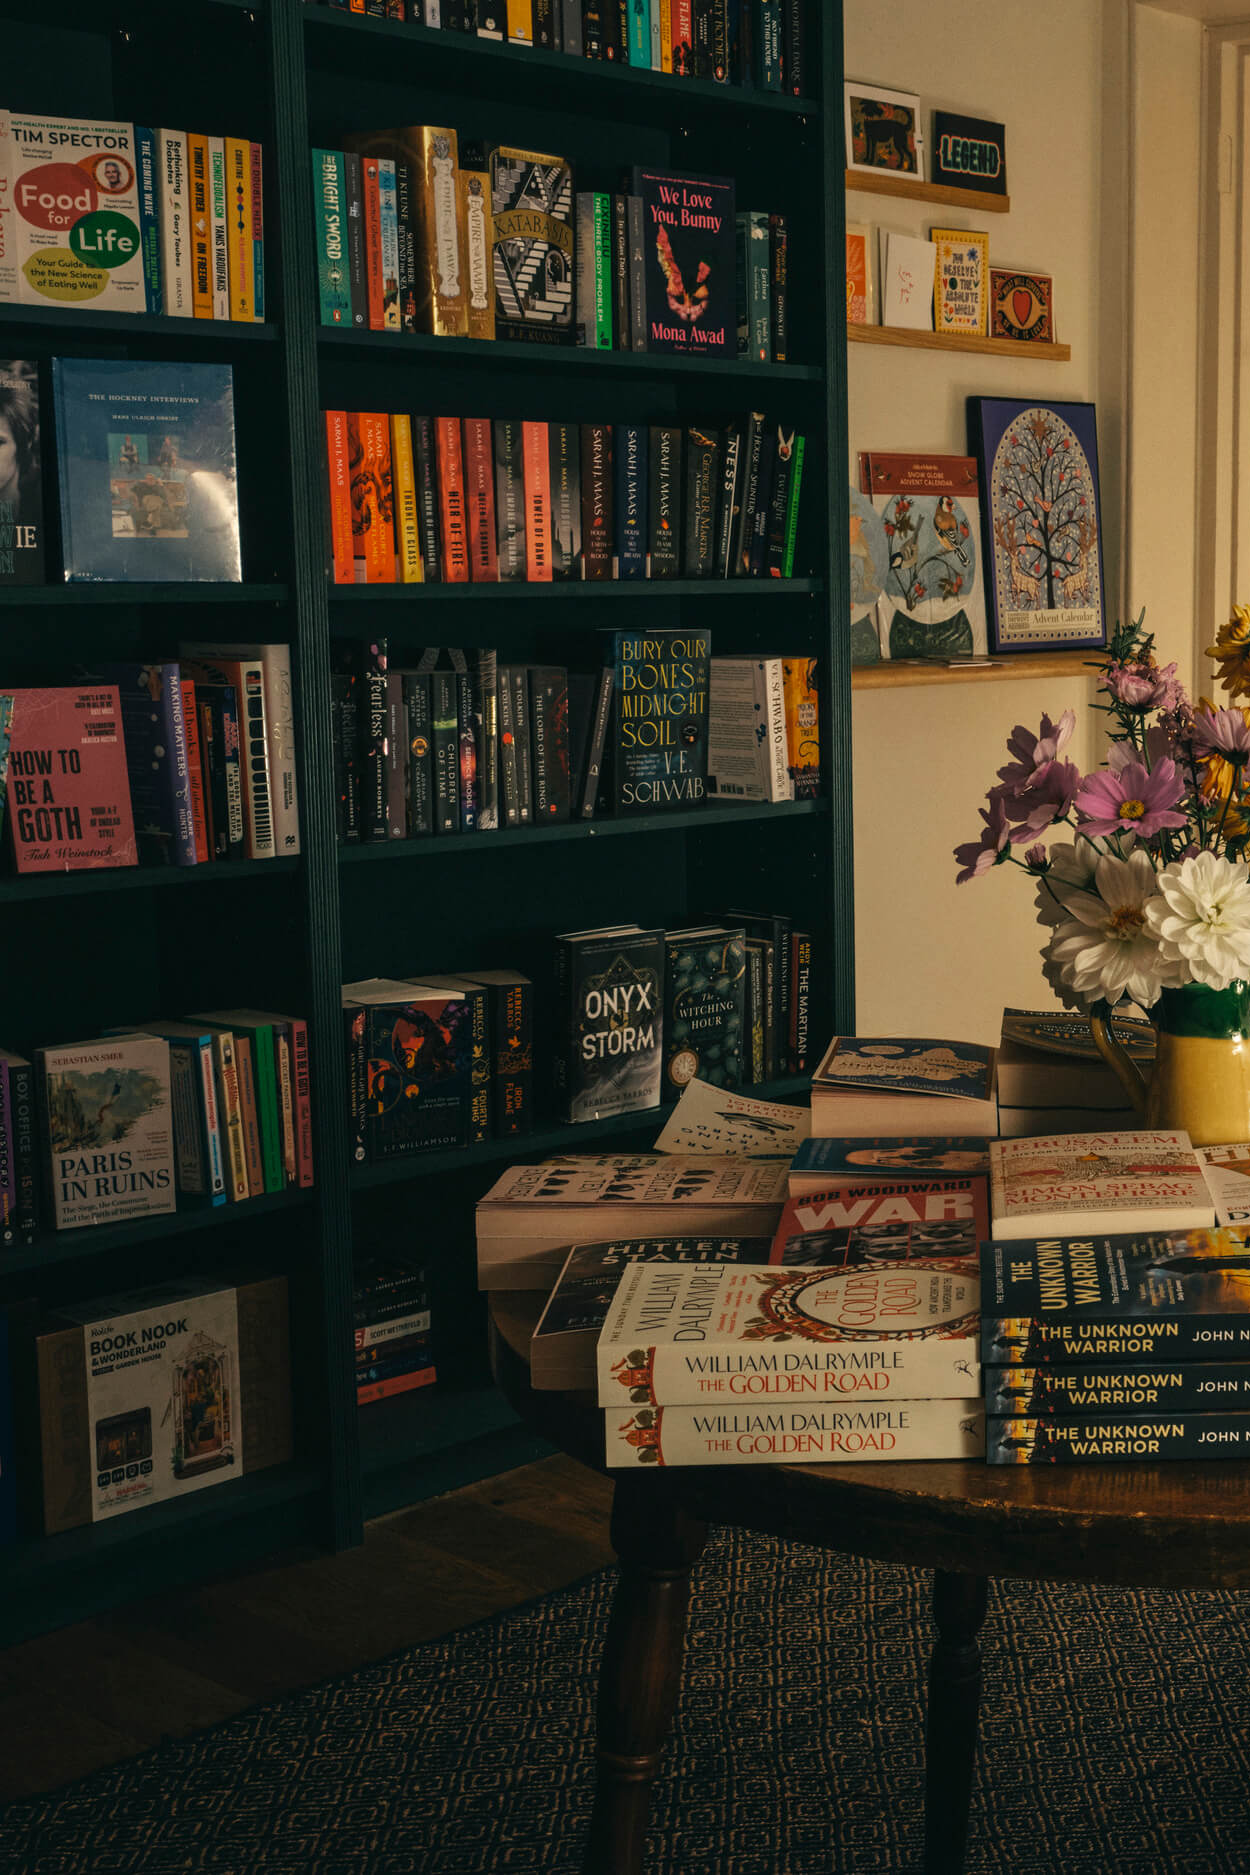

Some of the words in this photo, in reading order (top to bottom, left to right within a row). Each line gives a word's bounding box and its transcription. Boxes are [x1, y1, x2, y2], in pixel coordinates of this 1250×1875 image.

[11, 129, 44, 145] TIM
[48, 132, 129, 150] SPECTOR
[940, 135, 1000, 178] LEGEND
[19, 185, 93, 213] Food
[324, 164, 340, 213] BRIGHT
[659, 186, 678, 206] We
[682, 189, 713, 209] Love
[48, 211, 71, 227] for
[494, 211, 571, 248] KATABASIS
[651, 205, 677, 226] You,
[681, 210, 722, 233] Bunny
[78, 228, 134, 254] Life
[327, 216, 343, 260] SWORD
[30, 267, 45, 277] the
[47, 269, 68, 279] New
[70, 270, 103, 281] Science
[37, 277, 46, 287] of
[48, 278, 78, 291] Eating
[80, 280, 98, 290] Well
[652, 323, 686, 340] Mona
[689, 327, 724, 344] Awad
[150, 396, 199, 404] INTERVIEWS
[448, 492, 459, 517] HEIR
[450, 522, 460, 534] OF
[451, 539, 463, 566] FIRE
[1032, 612, 1058, 623] Advent
[1060, 612, 1094, 622] Calendar
[622, 640, 662, 660] BURY
[670, 639, 707, 659] OUR
[622, 664, 695, 692] BONES
[169, 675, 182, 723] MAKING
[622, 692, 706, 718] MIDNIGHT
[622, 721, 676, 748] SOIL
[12, 751, 53, 776] HOW
[58, 749, 81, 774] TO
[174, 726, 186, 776] MATTERS
[664, 750, 693, 775] V.E.
[15, 780, 36, 805] BE
[42, 779, 54, 803] A
[622, 777, 704, 805] SCHWAB
[18, 807, 82, 842] GOTH
[799, 966, 809, 992] THE
[585, 982, 652, 1020] ONYX
[678, 1001, 735, 1020] WITCHING
[690, 1017, 722, 1030] HOUR
[799, 994, 808, 1054] MARTIAN
[582, 1025, 655, 1060] STORM
[61, 1152, 132, 1178] PARIS
[63, 1181, 90, 1202] IN
[94, 1169, 170, 1197] RUINS
[847, 1180, 972, 1197] WOODWARD
[792, 1193, 974, 1232] WAR
[90, 1333, 137, 1356] BOOK
[142, 1318, 188, 1342] NOOK
[1039, 1325, 1076, 1339] THE
[1079, 1323, 1179, 1338] UNKNOWN
[1192, 1331, 1235, 1342] JOHN
[1065, 1338, 1154, 1354] WARRIOR
[685, 1354, 776, 1373] WILLIAM
[781, 1351, 904, 1371] DALRYMPLE
[698, 1378, 726, 1392] THE
[729, 1374, 817, 1394] GOLDEN
[823, 1371, 890, 1392] ROAD
[694, 1414, 787, 1434] WILLIAM
[791, 1412, 910, 1432] DALRYMPLE
[705, 1439, 733, 1452] THE
[736, 1435, 824, 1455] GOLDEN
[830, 1433, 896, 1452] ROAD
